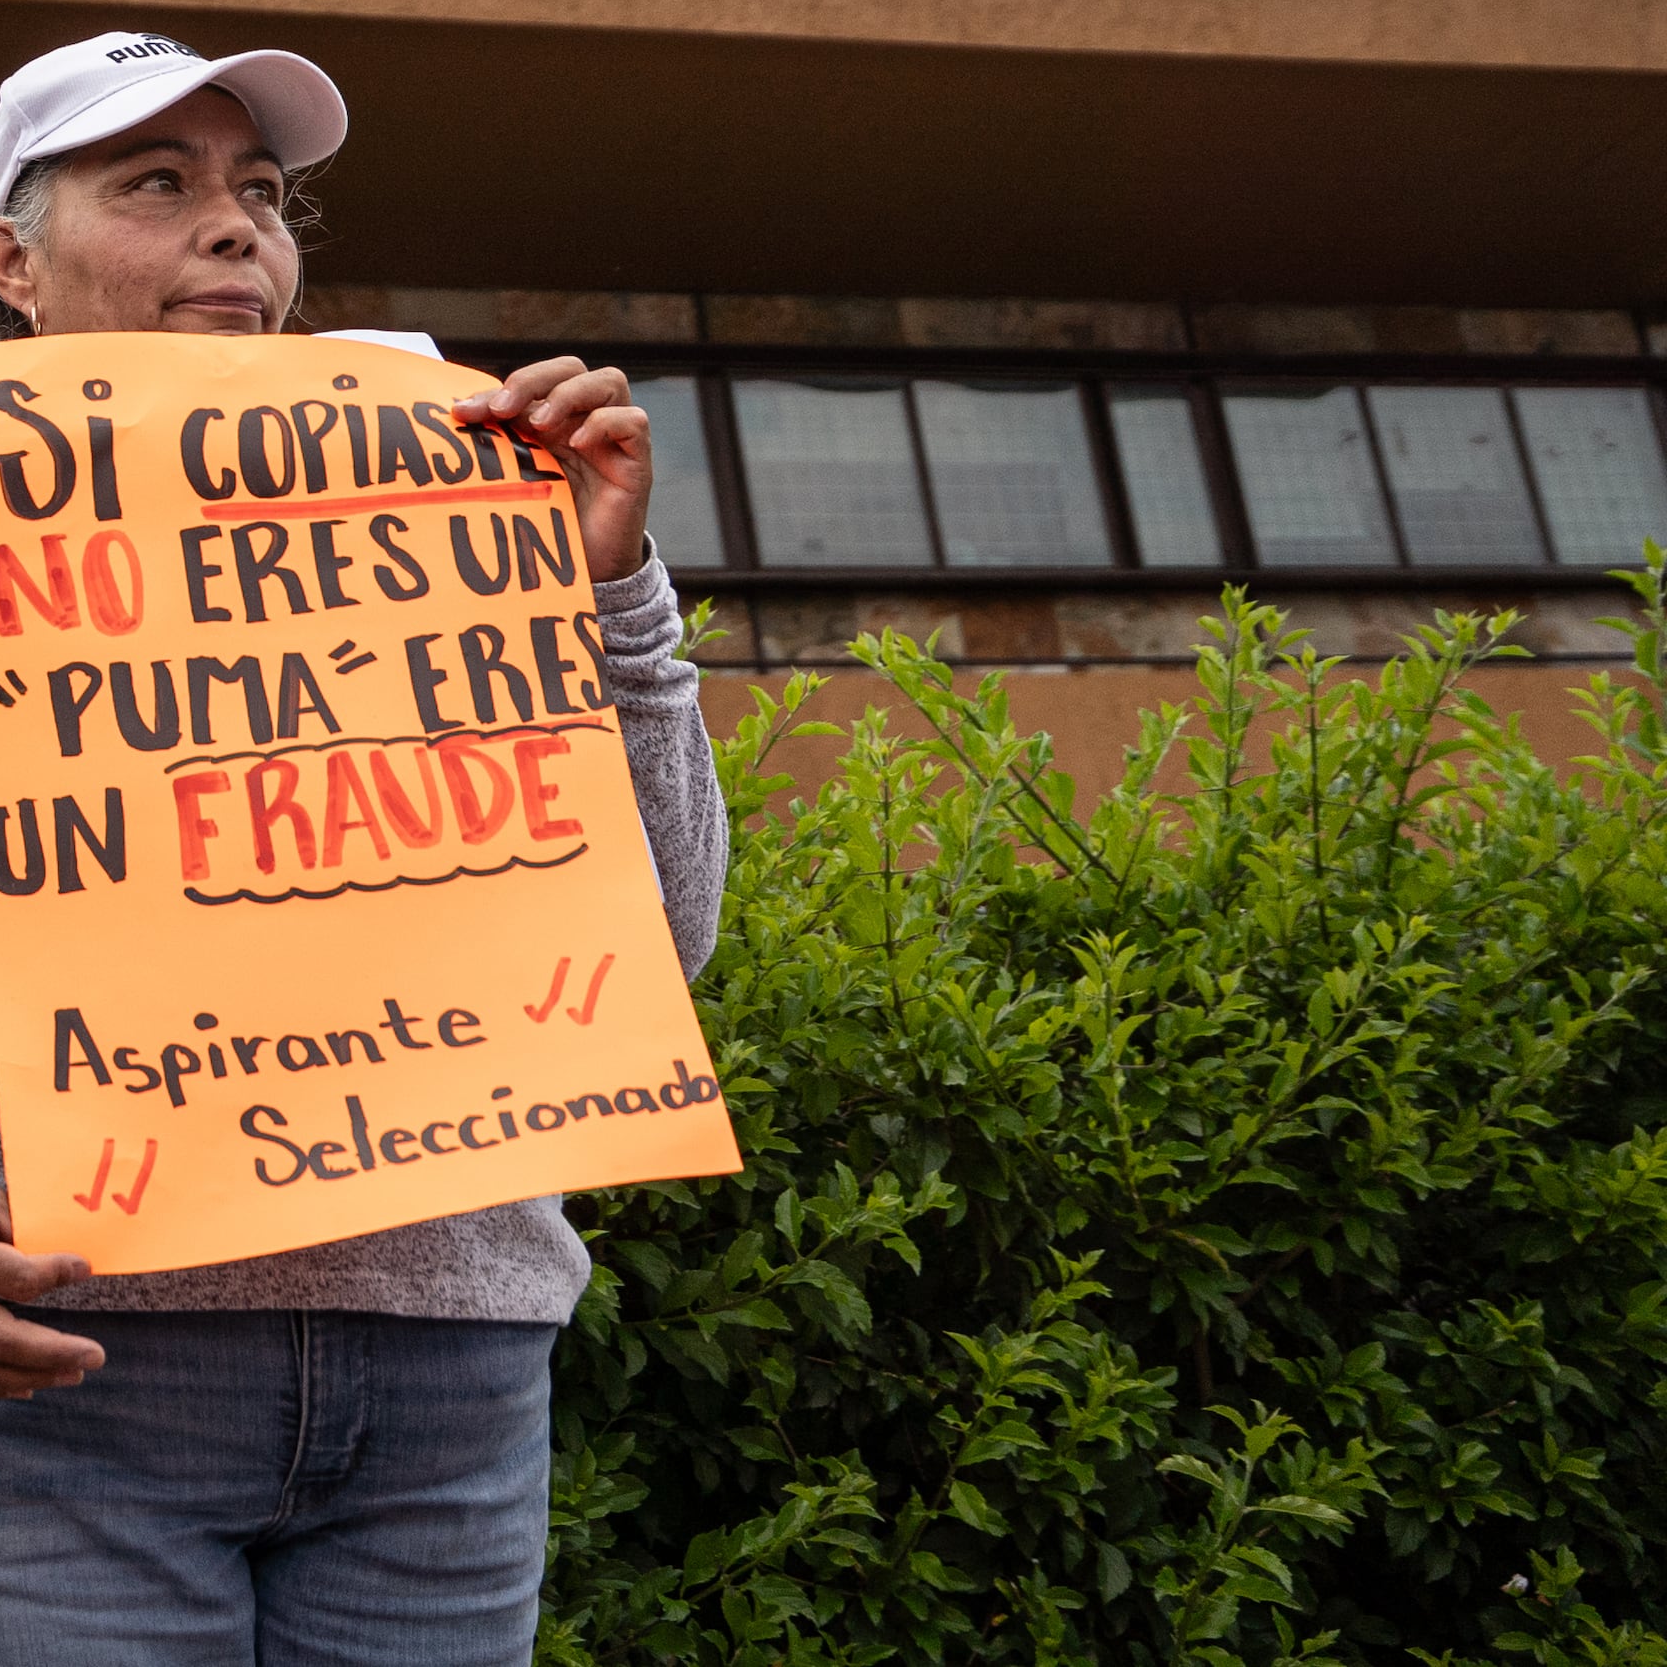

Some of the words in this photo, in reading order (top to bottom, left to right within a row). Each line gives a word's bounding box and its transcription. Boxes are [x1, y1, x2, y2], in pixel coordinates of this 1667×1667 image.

[179, 513, 431, 623] ERES
[449, 506, 578, 597] UN
[403, 611, 616, 733] ERES
[172, 734, 585, 883] FRAUDE
[52, 997, 488, 1108] Aspirante
[238, 1058, 720, 1188] Seleccionado
